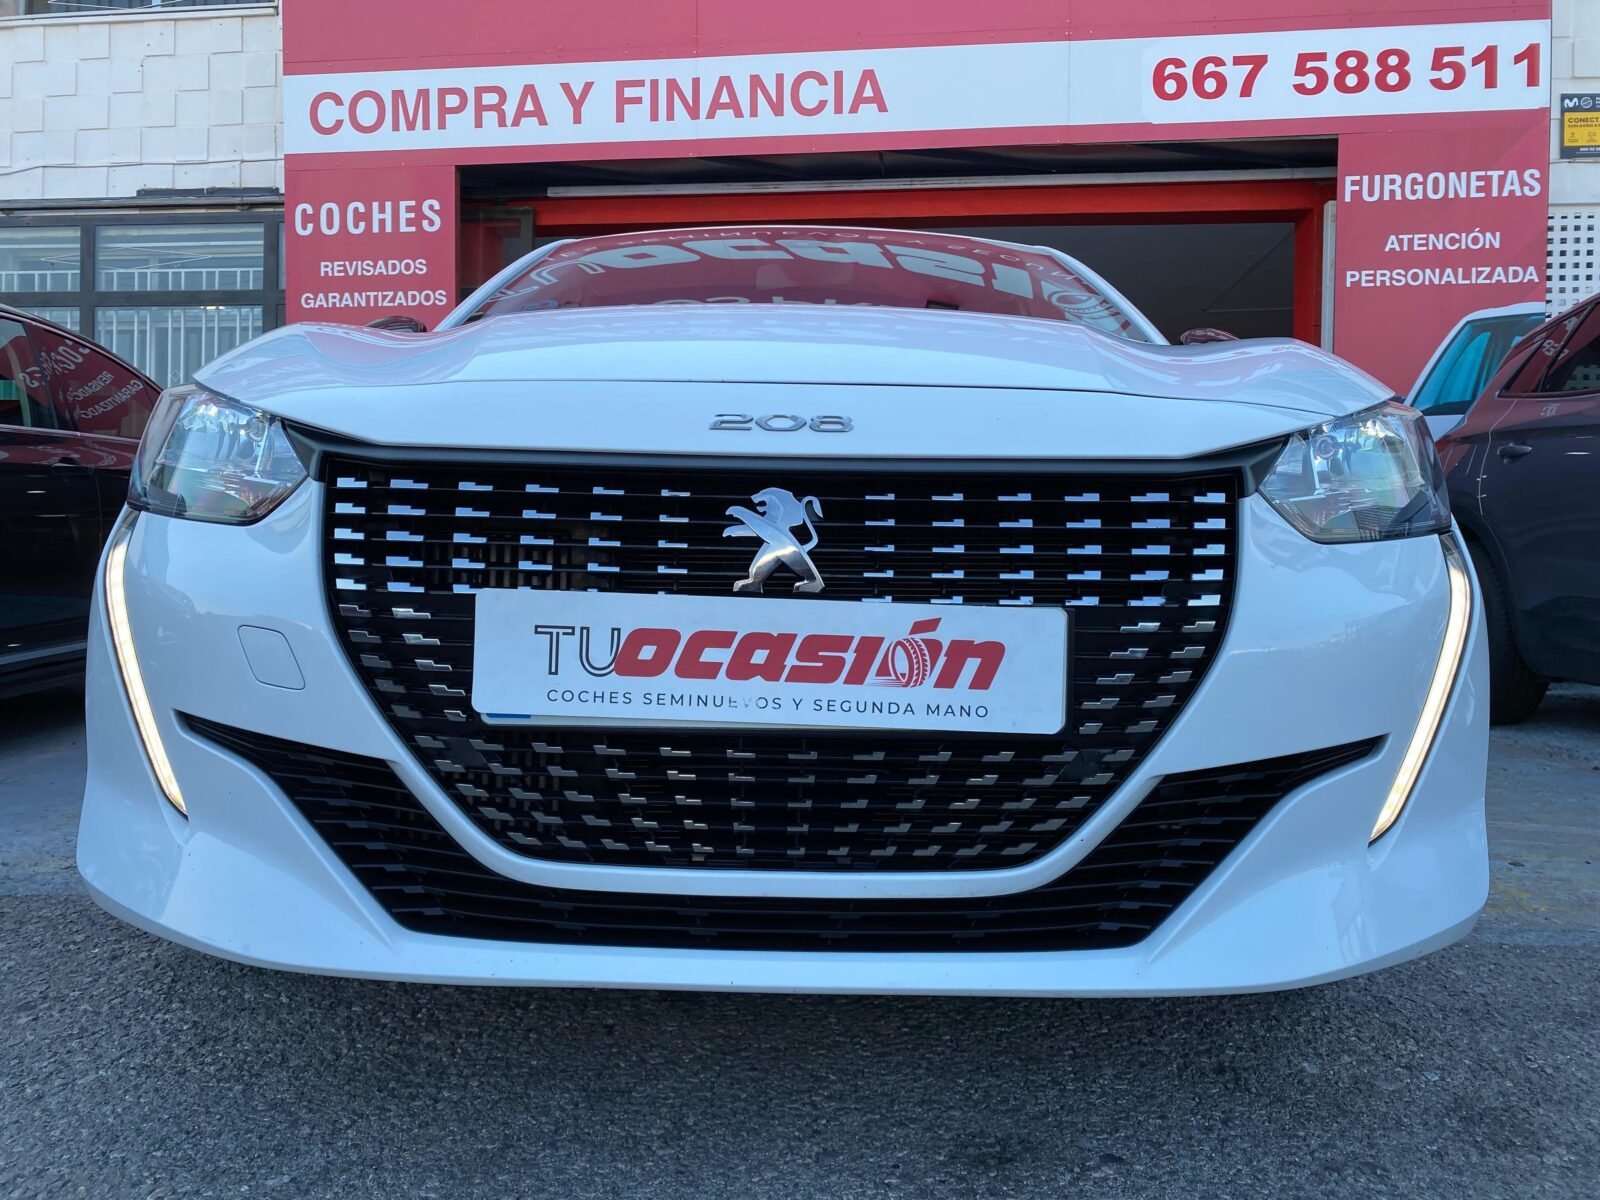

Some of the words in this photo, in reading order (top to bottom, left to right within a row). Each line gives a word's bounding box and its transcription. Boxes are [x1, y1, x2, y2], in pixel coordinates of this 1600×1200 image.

[1151, 54, 1269, 102] 667
[1292, 48, 1412, 97] 588
[1430, 43, 1540, 91] 511
[310, 84, 547, 135] COMPRA
[560, 81, 593, 125] Y
[615, 69, 888, 123] FINANCIA
[1344, 168, 1541, 203] FURGONETAS
[294, 198, 441, 236] COCHES
[1384, 227, 1501, 252] ATENCIÓN
[320, 258, 427, 277] REVISADOS
[1345, 265, 1540, 288] PERSONALIZADA
[300, 289, 447, 309] GARANTIZADOS
[708, 413, 855, 433] 208
[546, 688, 633, 705] COCHES
[792, 698, 803, 711] Y
[813, 698, 915, 716] SEGUNDA
[926, 703, 989, 718] MANO
